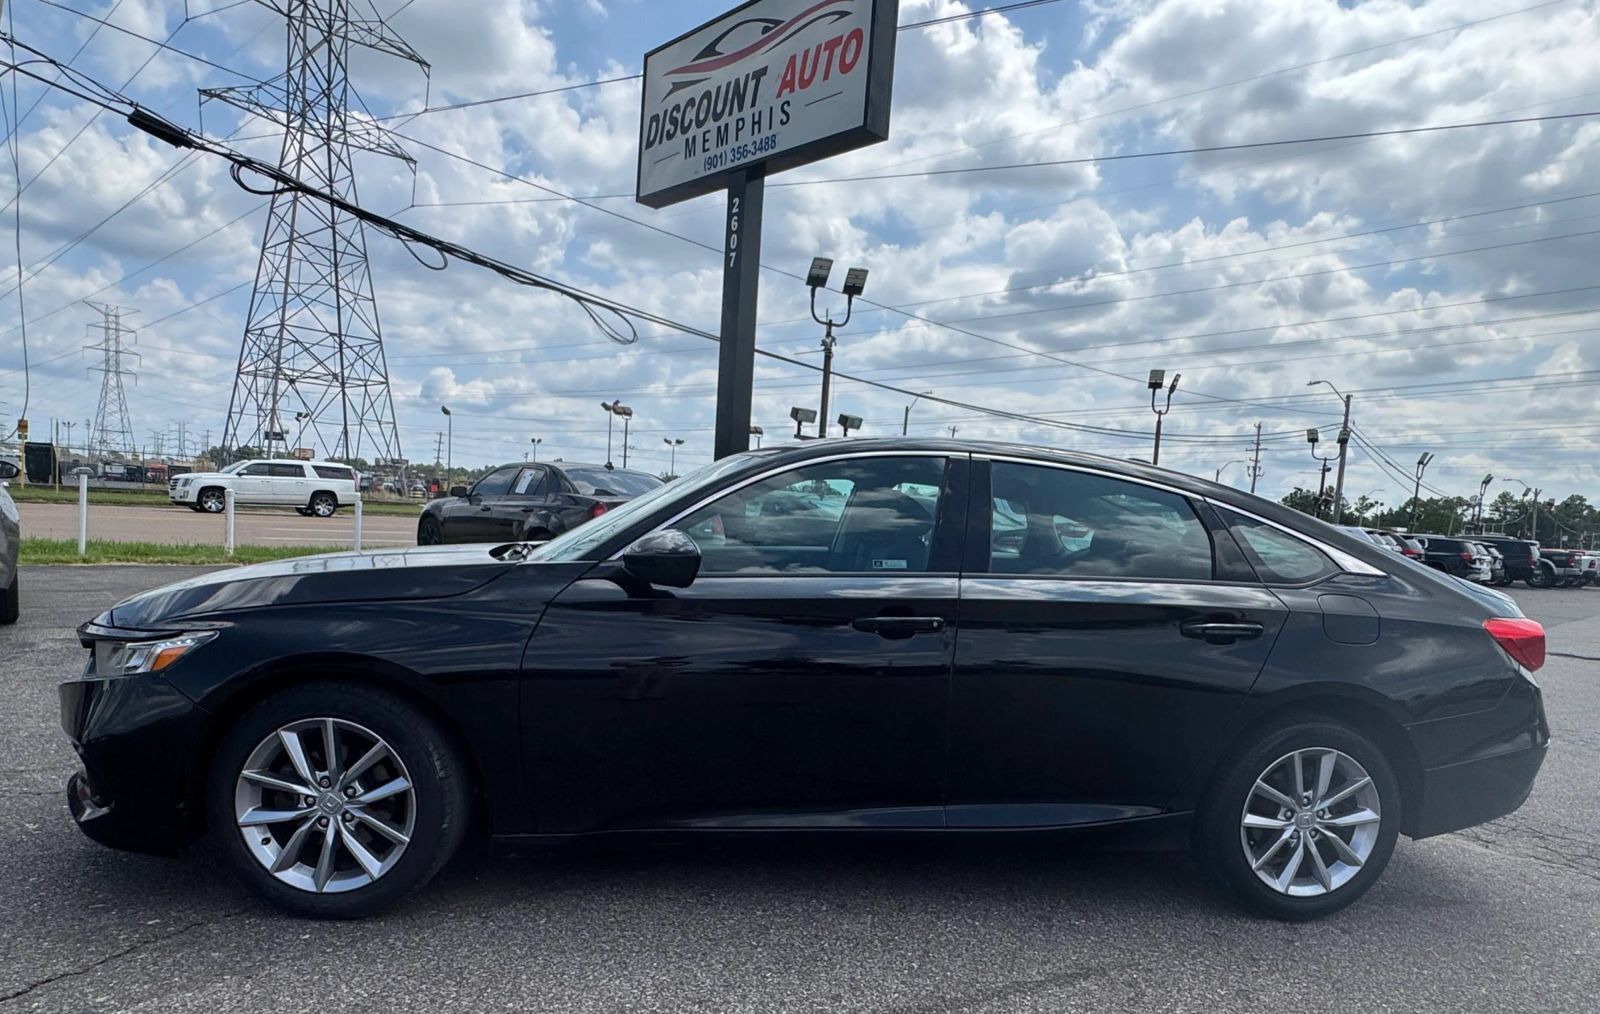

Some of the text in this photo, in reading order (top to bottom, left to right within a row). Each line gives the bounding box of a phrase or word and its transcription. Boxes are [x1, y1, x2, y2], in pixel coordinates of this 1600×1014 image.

[645, 27, 864, 150] DISCOUNT AUTO
[684, 100, 791, 160] MEMPHIS
[703, 134, 777, 171] (901) 356-3488
[729, 197, 740, 268] 2607
